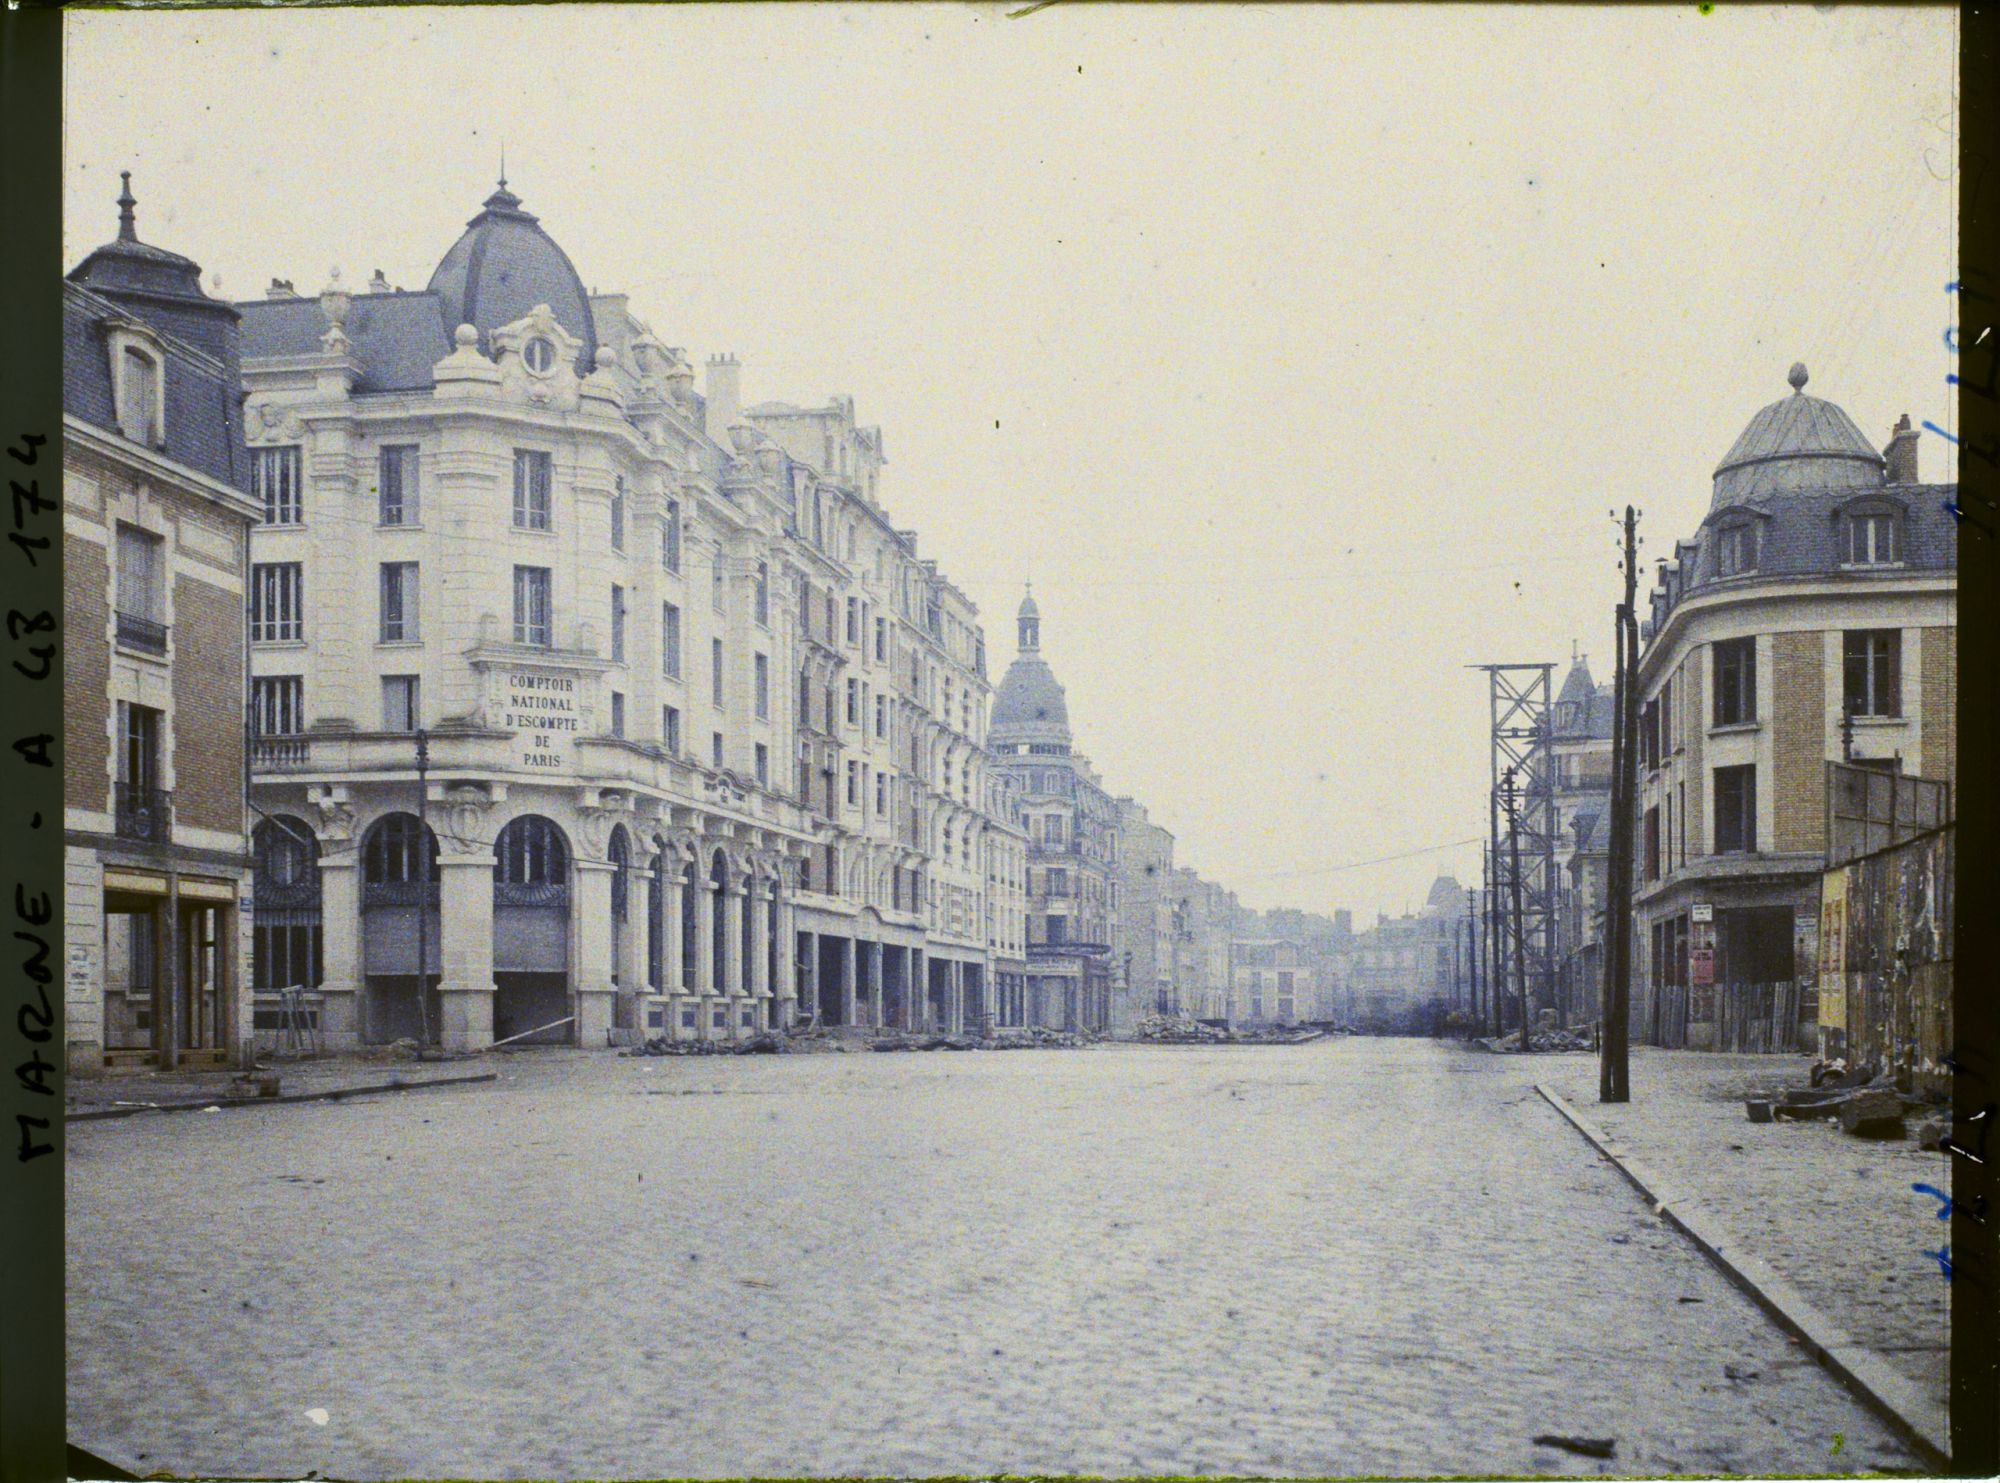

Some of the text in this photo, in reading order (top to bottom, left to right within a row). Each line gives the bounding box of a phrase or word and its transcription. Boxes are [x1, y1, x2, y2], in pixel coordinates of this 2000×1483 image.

[7, 432, 59, 568] 174
[510, 675, 573, 692] COMPTOIR
[511, 695, 574, 712] NATIONAL
[535, 735, 550, 748] DE
[11, 733, 56, 768] A
[523, 753, 561, 768] PARIS
[13, 882, 57, 1164] MARNE
